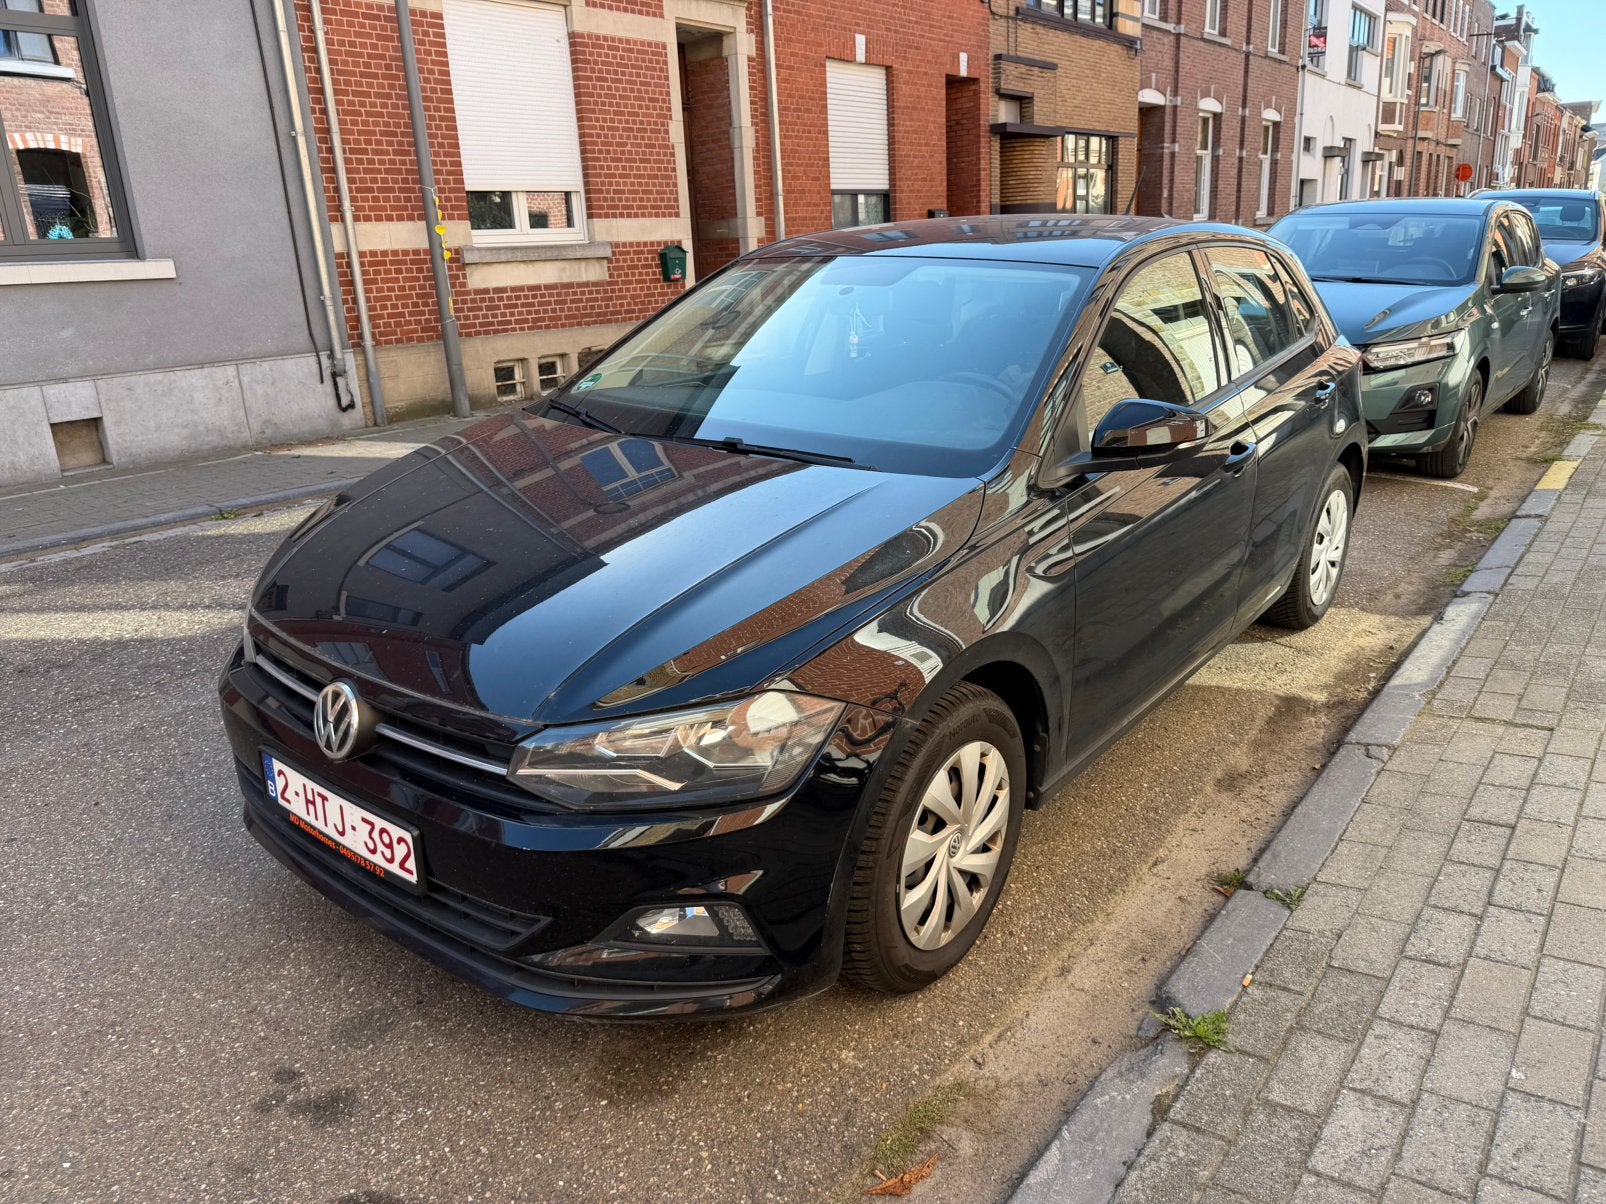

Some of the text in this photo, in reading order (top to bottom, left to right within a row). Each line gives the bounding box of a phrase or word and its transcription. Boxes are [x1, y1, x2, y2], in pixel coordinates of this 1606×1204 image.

[268, 780, 276, 797] B
[277, 769, 414, 876] 2-HTJ-392
[289, 812, 300, 825] MD
[300, 821, 336, 849] Motorhomes
